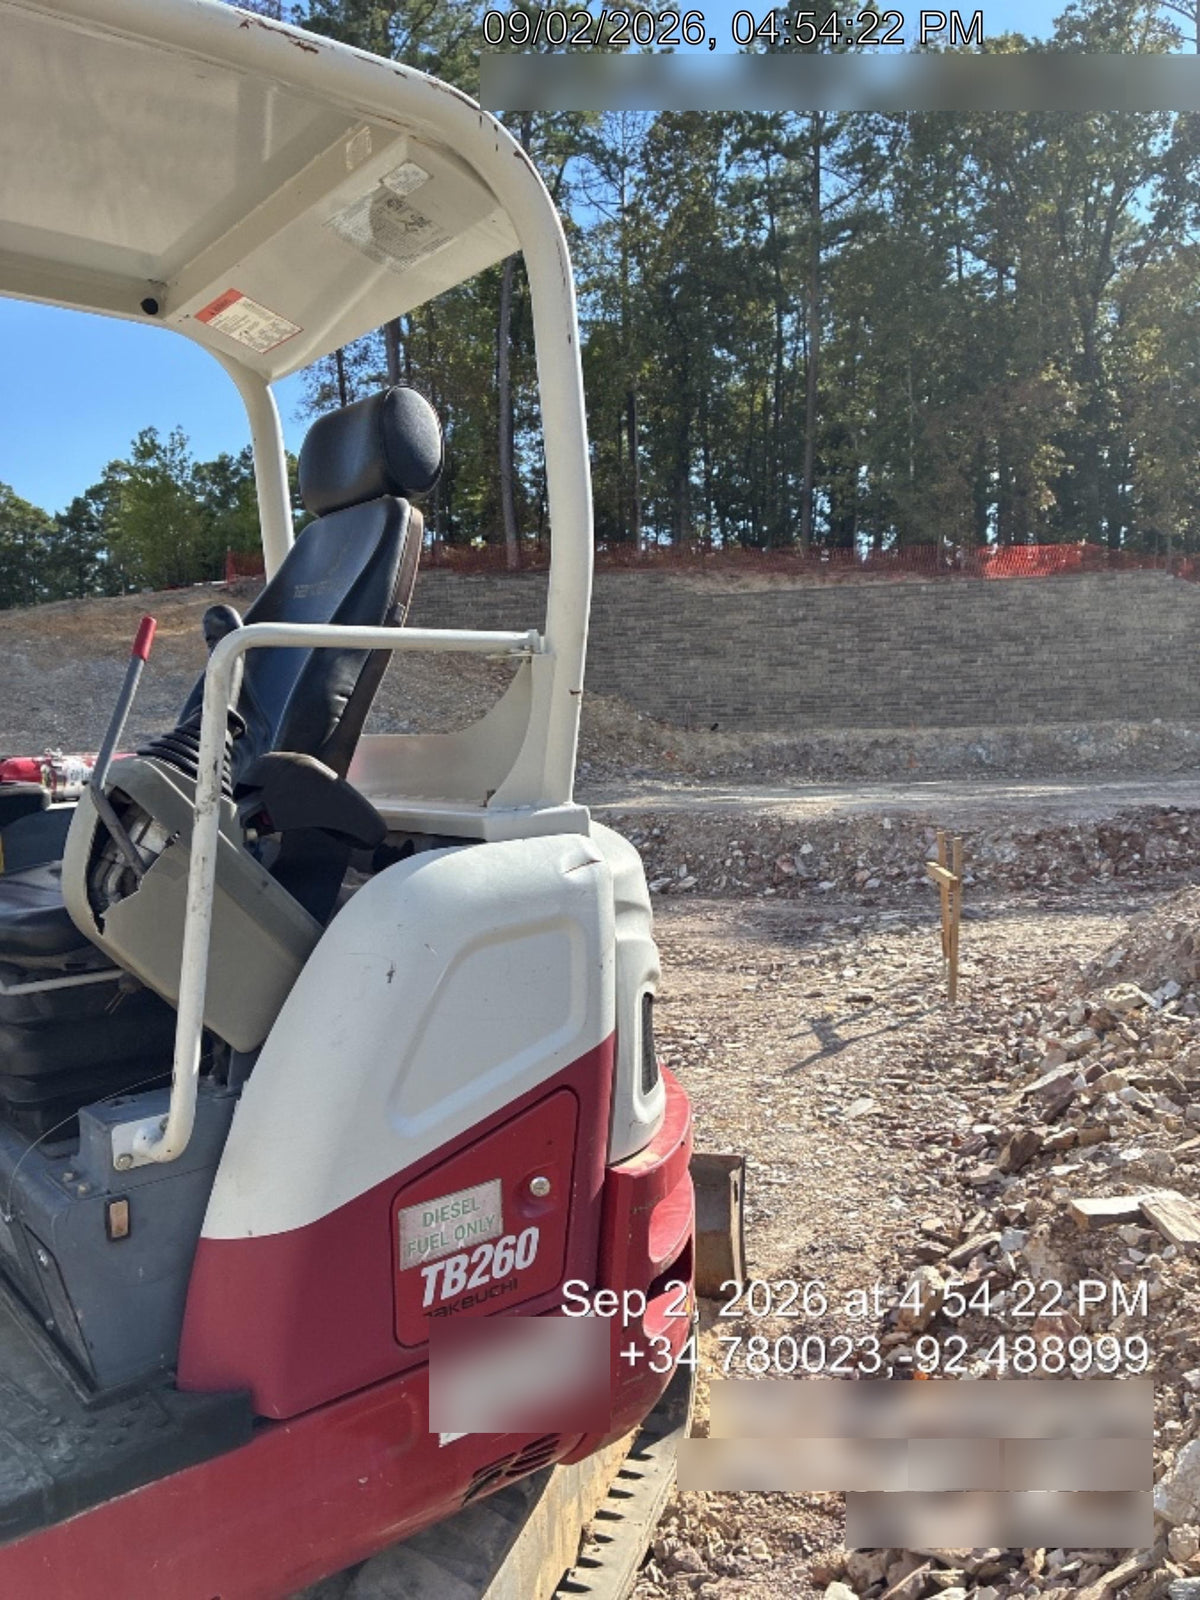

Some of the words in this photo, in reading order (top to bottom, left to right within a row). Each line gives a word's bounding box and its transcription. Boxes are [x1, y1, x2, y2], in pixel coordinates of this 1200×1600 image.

[422, 1198, 480, 1227] DIESEL
[408, 1231, 449, 1257] FUEL
[454, 1215, 495, 1241] ONLY
[420, 1226, 540, 1308] TB260
